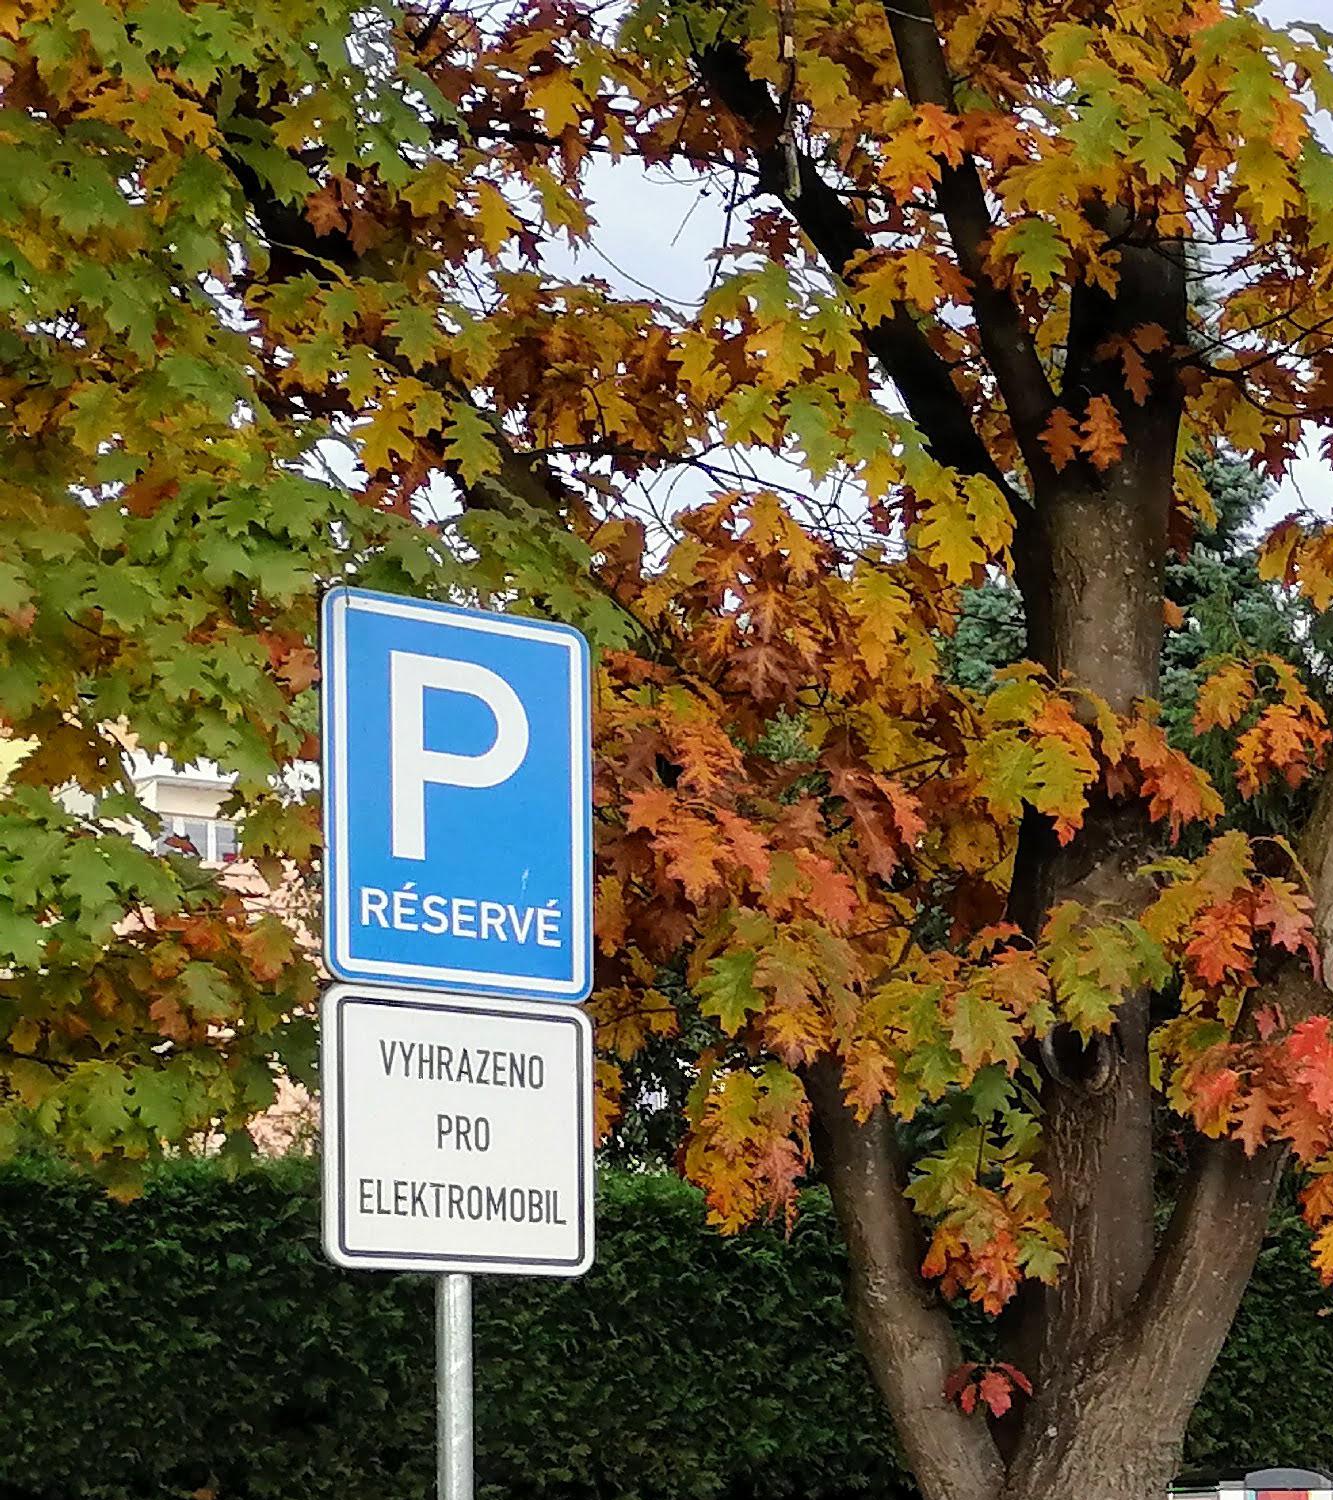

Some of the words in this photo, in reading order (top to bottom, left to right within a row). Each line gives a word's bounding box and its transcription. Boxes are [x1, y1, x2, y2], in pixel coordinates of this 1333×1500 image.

[388, 649, 531, 862] P
[359, 880, 563, 948] RÉSERVÉ
[378, 1038, 545, 1090] VYHRAZENO
[435, 1113, 491, 1152] PRO
[358, 1177, 568, 1227] ELEKTROMOBIL
